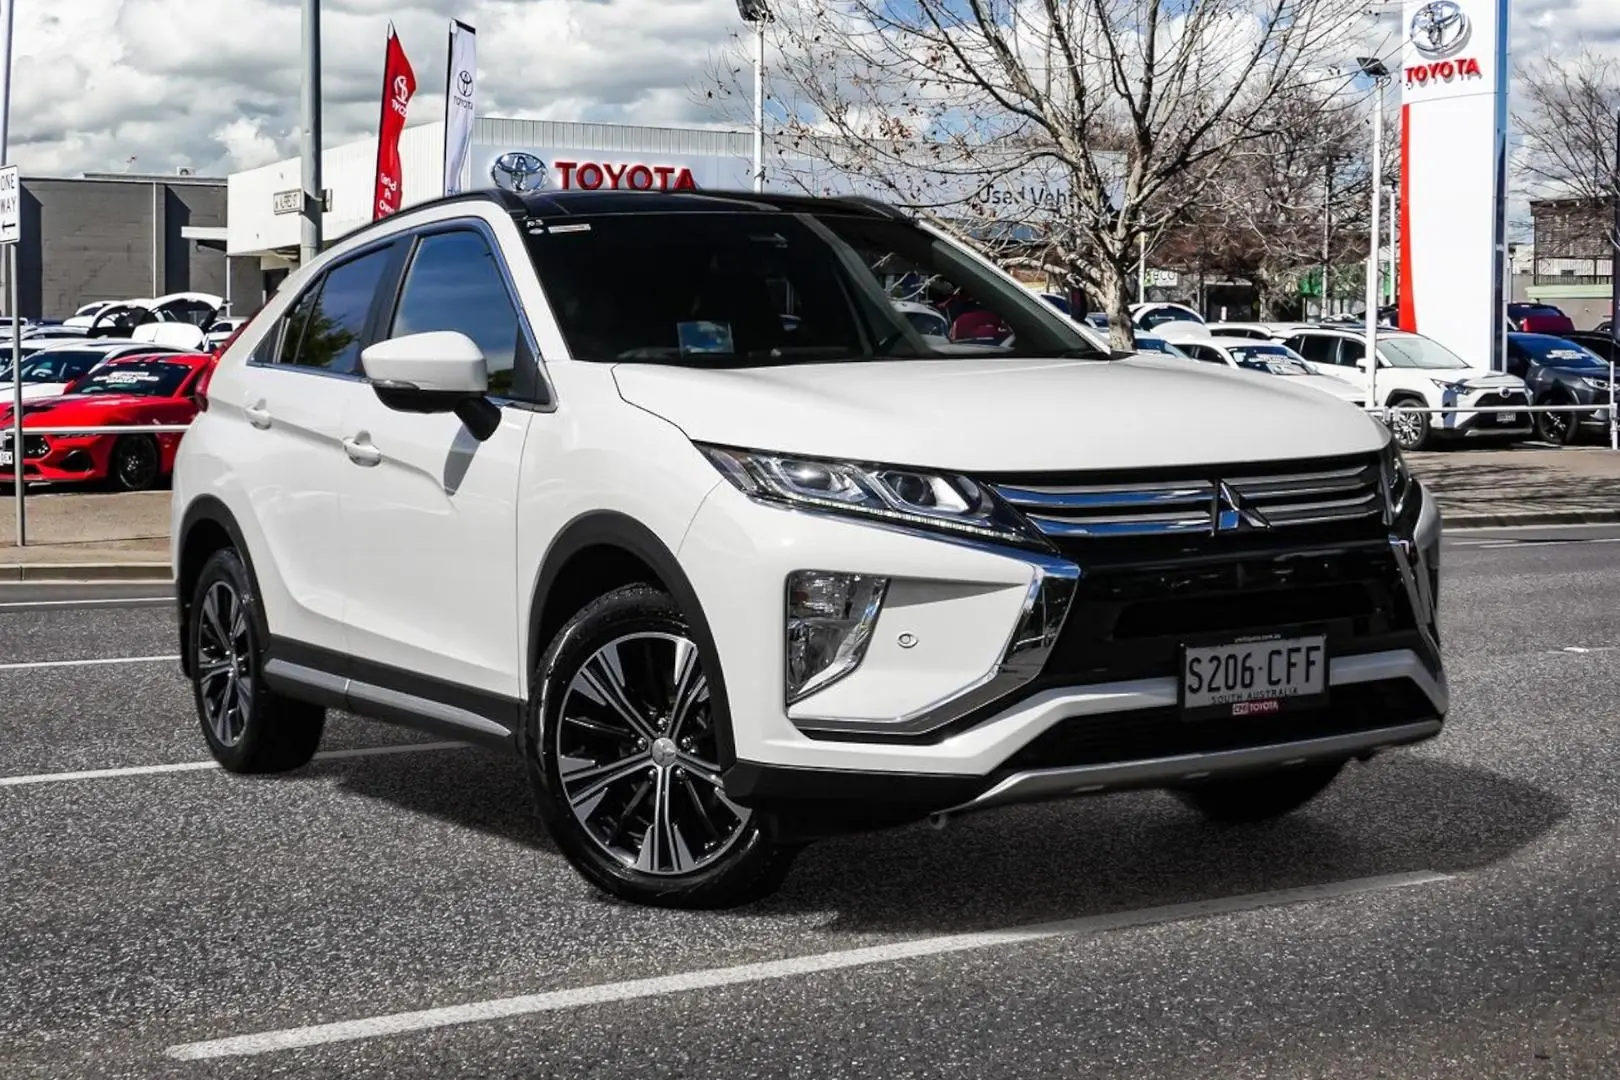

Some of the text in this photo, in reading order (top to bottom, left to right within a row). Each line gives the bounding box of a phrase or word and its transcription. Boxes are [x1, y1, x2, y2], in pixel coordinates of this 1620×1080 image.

[1404, 58, 1480, 83] TOYOTA
[1, 173, 15, 191] ONE
[555, 161, 697, 191] TOYOTA
[979, 185, 1024, 205] Used
[0, 196, 17, 214] WAY
[1211, 687, 1298, 704] SOUTH AUSTRALIA
[1250, 701, 1279, 713] TOYOTA
